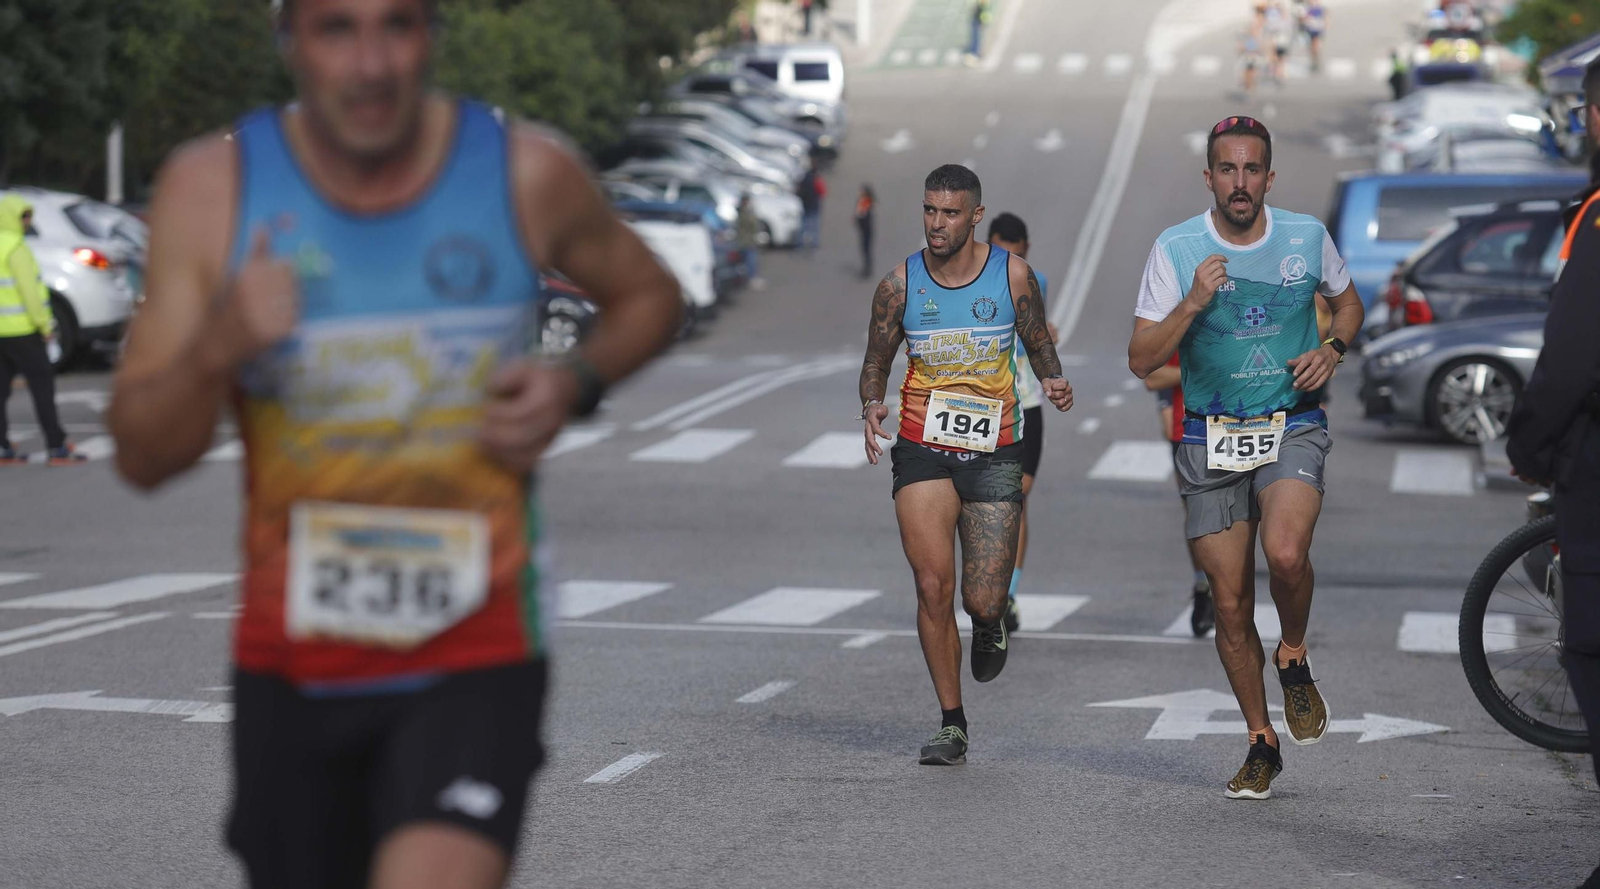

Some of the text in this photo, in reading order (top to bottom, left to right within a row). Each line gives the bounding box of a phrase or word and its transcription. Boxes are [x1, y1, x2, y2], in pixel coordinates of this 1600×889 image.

[931, 332, 970, 351] TRAIL
[923, 350, 961, 364] TEAM
[1231, 367, 1287, 379] MOBILITY BALANCE
[935, 411, 991, 438] 194
[1215, 434, 1275, 458] 455
[312, 556, 453, 618] 236
